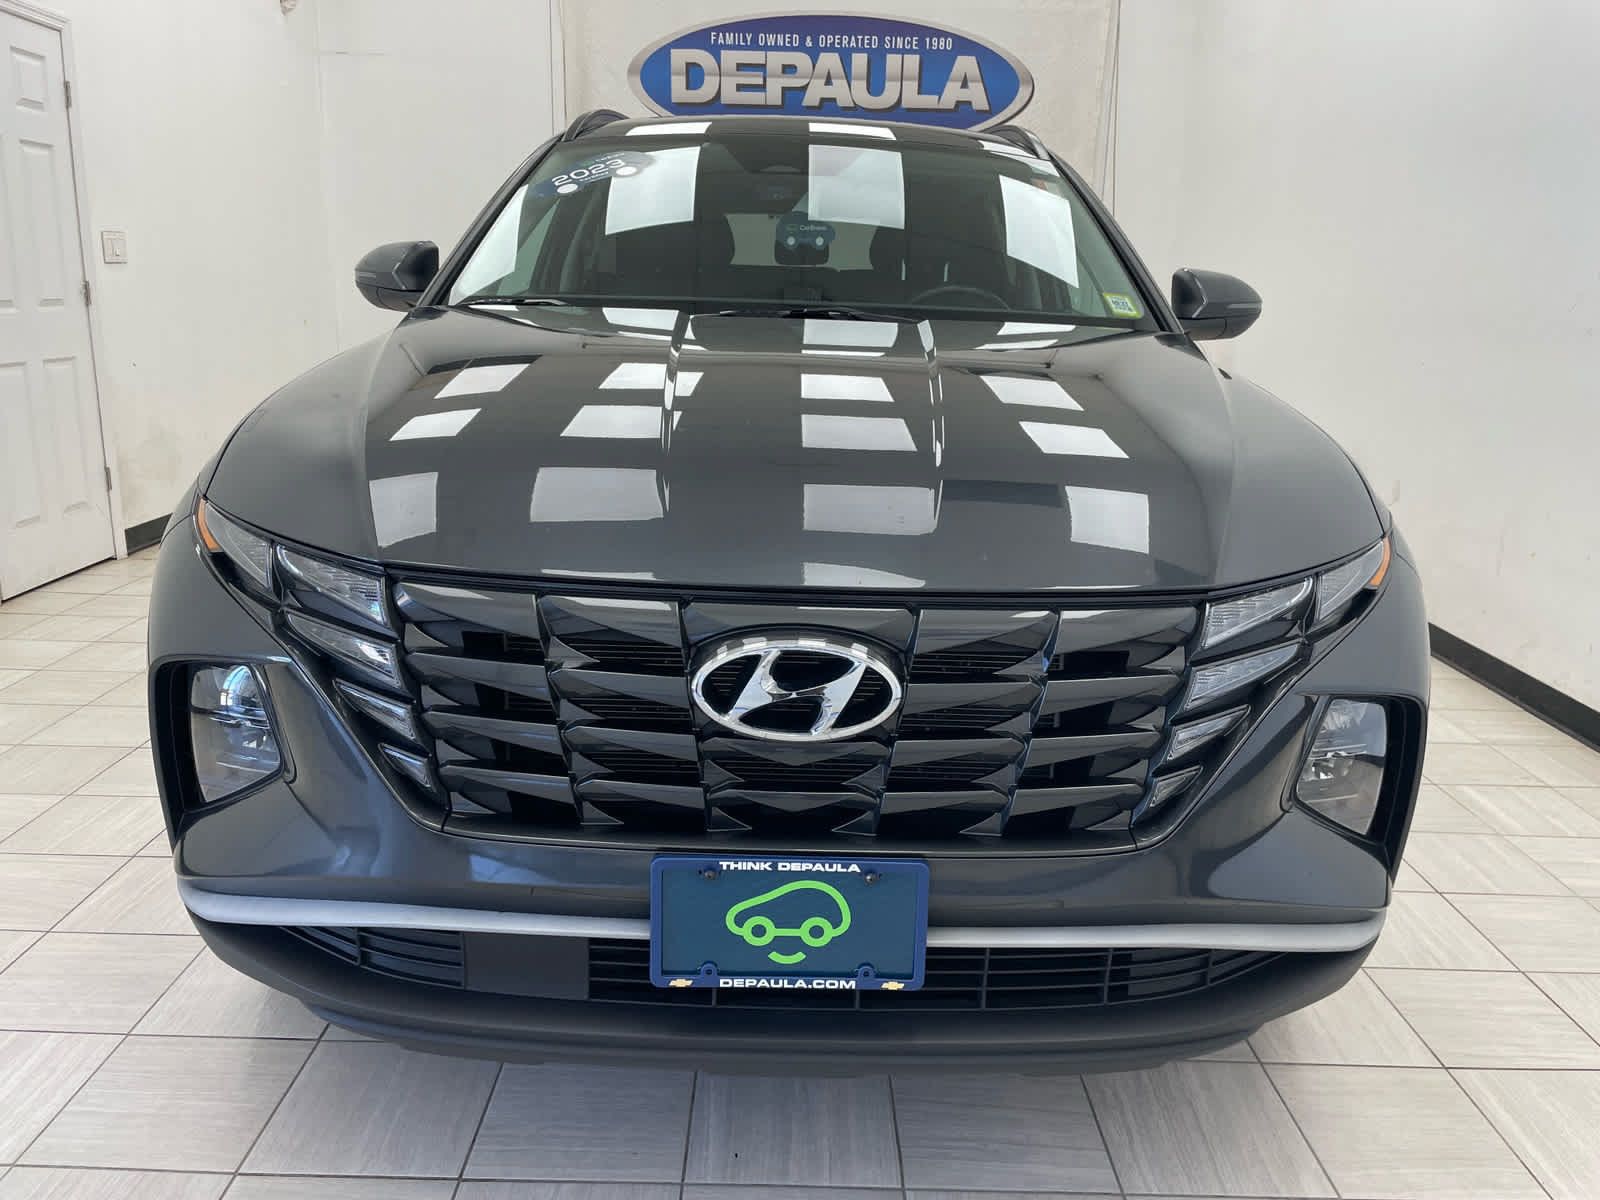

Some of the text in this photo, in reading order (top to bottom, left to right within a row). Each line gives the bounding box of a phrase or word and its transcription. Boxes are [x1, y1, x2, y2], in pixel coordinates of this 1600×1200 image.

[711, 31, 953, 51] FAMILY OWNED & OPERATED SINCE 1980
[670, 48, 991, 112] DEPAULA
[551, 158, 627, 186] 2023
[719, 861, 862, 873] THINK DEPAULA
[719, 978, 856, 990] DEPAULA.COM
